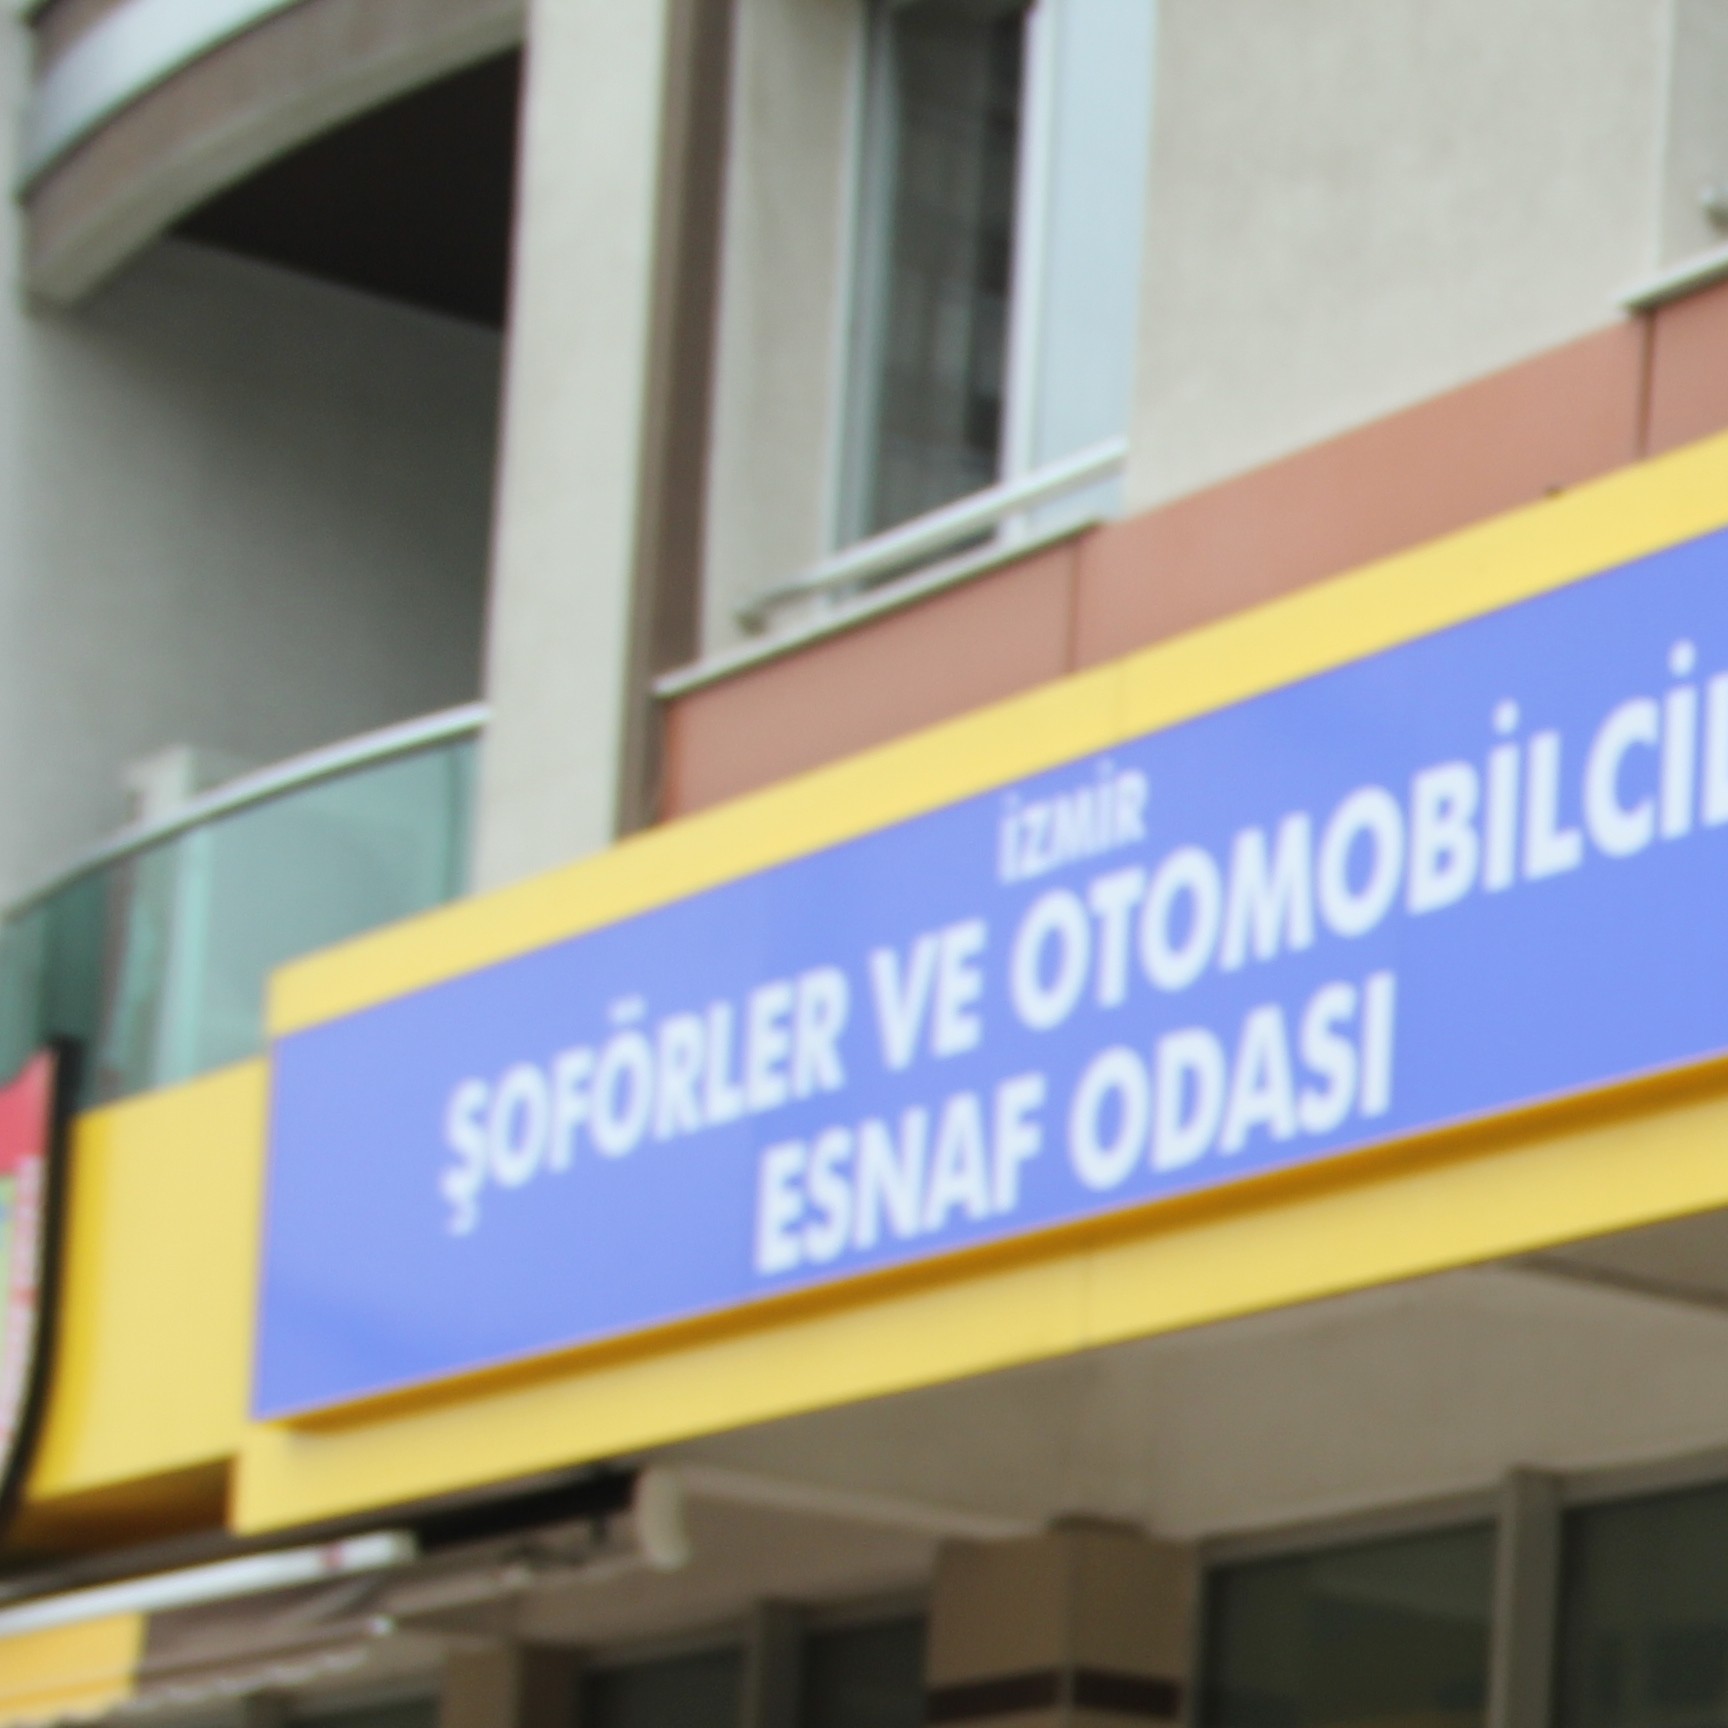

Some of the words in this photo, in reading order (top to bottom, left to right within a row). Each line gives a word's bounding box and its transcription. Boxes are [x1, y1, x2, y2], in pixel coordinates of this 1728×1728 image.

[997, 760, 1149, 885] İZMİR
[440, 967, 848, 1237] ŞOFÖRLER
[870, 919, 986, 1070] VE
[755, 1072, 1047, 1274] ESNAF
[1067, 970, 1395, 1192] ODASI
